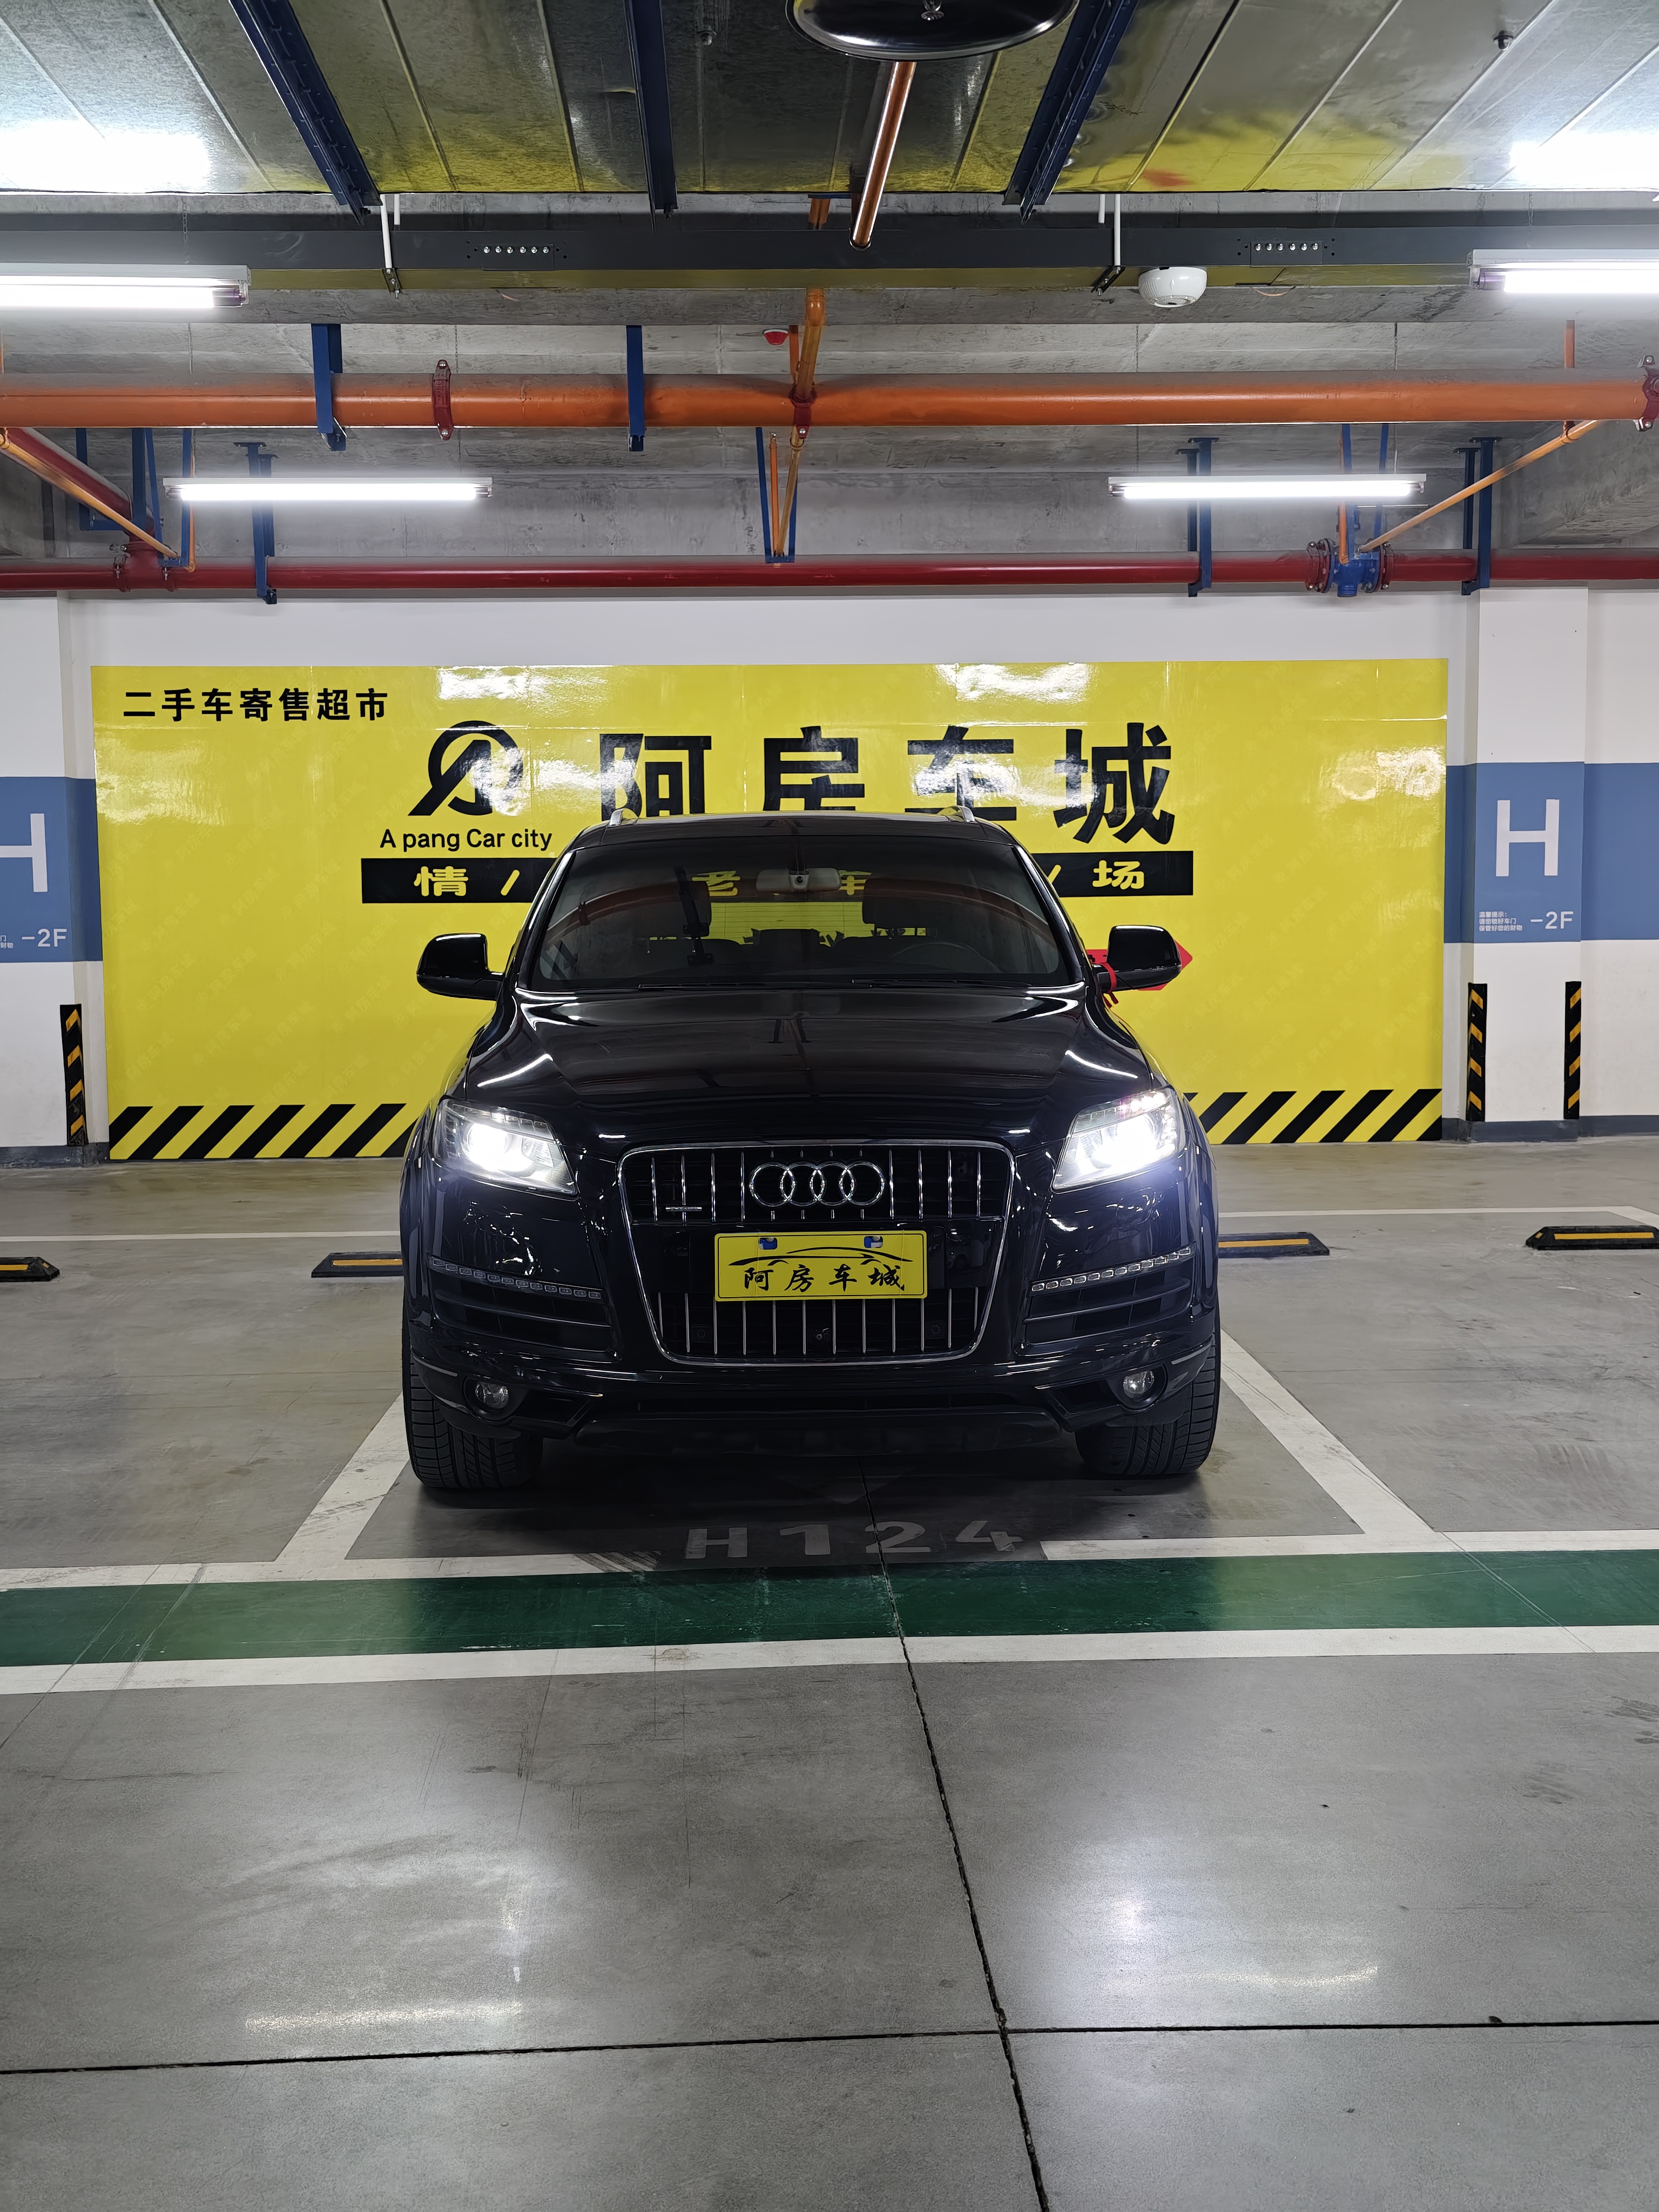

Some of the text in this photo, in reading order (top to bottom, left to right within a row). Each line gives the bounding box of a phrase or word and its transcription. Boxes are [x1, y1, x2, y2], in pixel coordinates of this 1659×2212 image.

[123, 687, 388, 722] 二手车寄售超市
[599, 723, 1175, 845] 阿房车城
[380, 828, 552, 853] A pang Car city
[1495, 799, 1560, 877] H
[413, 866, 469, 897] 情
[1092, 860, 1144, 890] 场
[744, 1264, 905, 1293] 阿房车城
[685, 1520, 1024, 1560] H124
